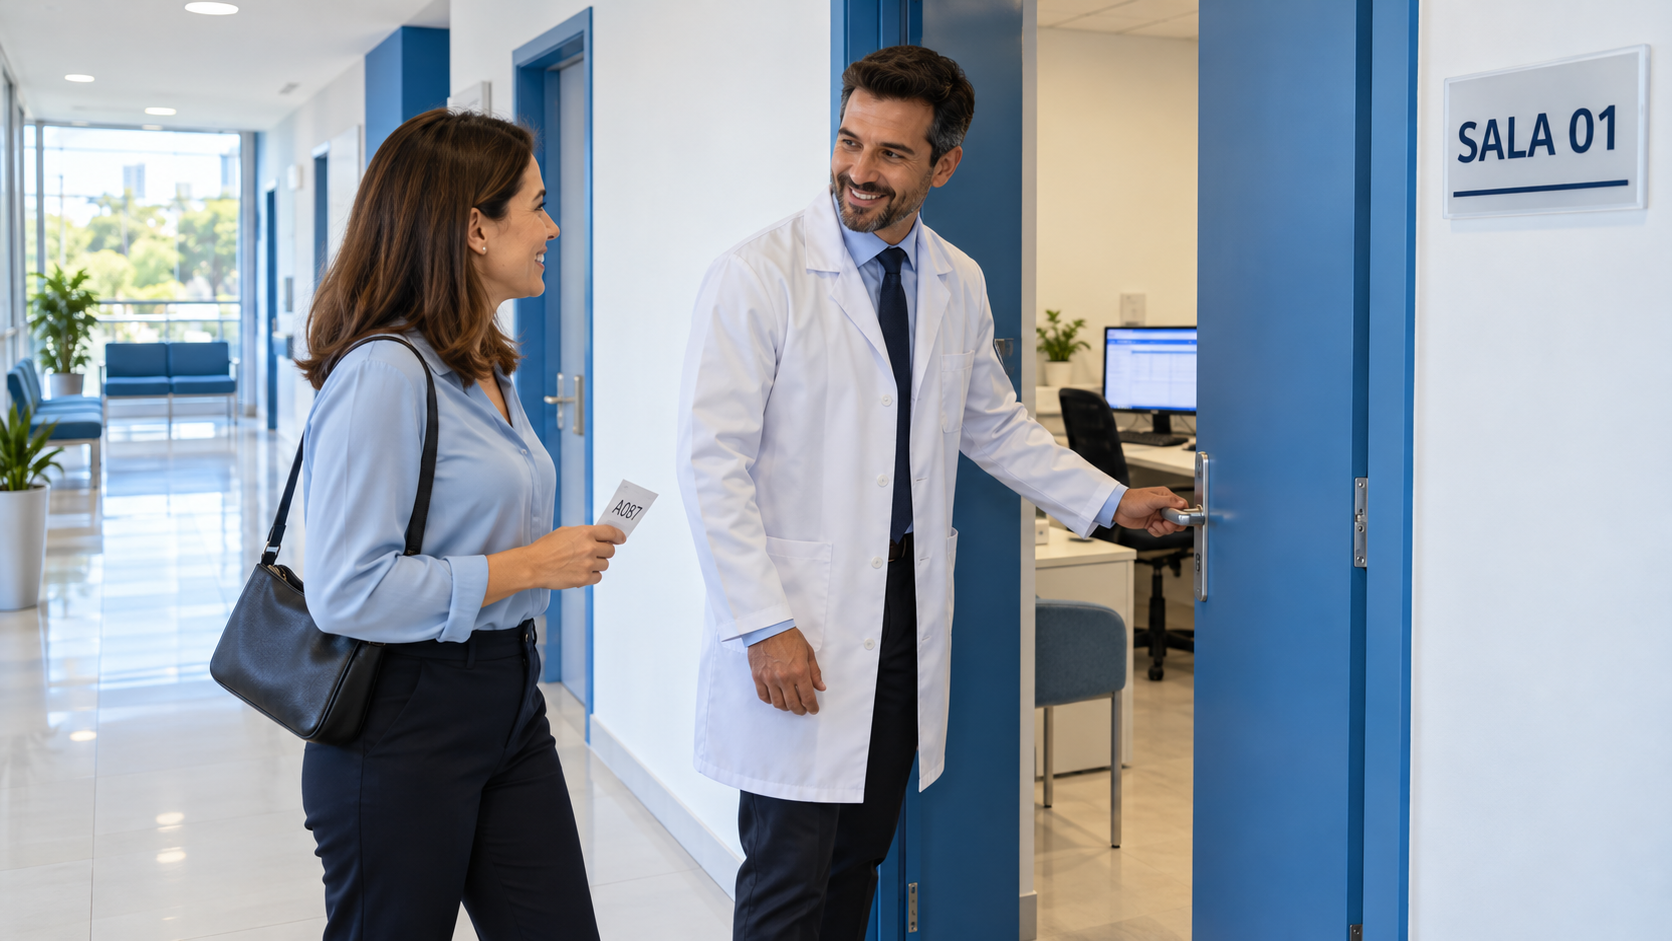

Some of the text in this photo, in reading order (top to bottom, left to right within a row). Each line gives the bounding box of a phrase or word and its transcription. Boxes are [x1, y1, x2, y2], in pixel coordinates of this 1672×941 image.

[1457, 104, 1616, 164] SALA 01
[611, 499, 643, 521] A087
